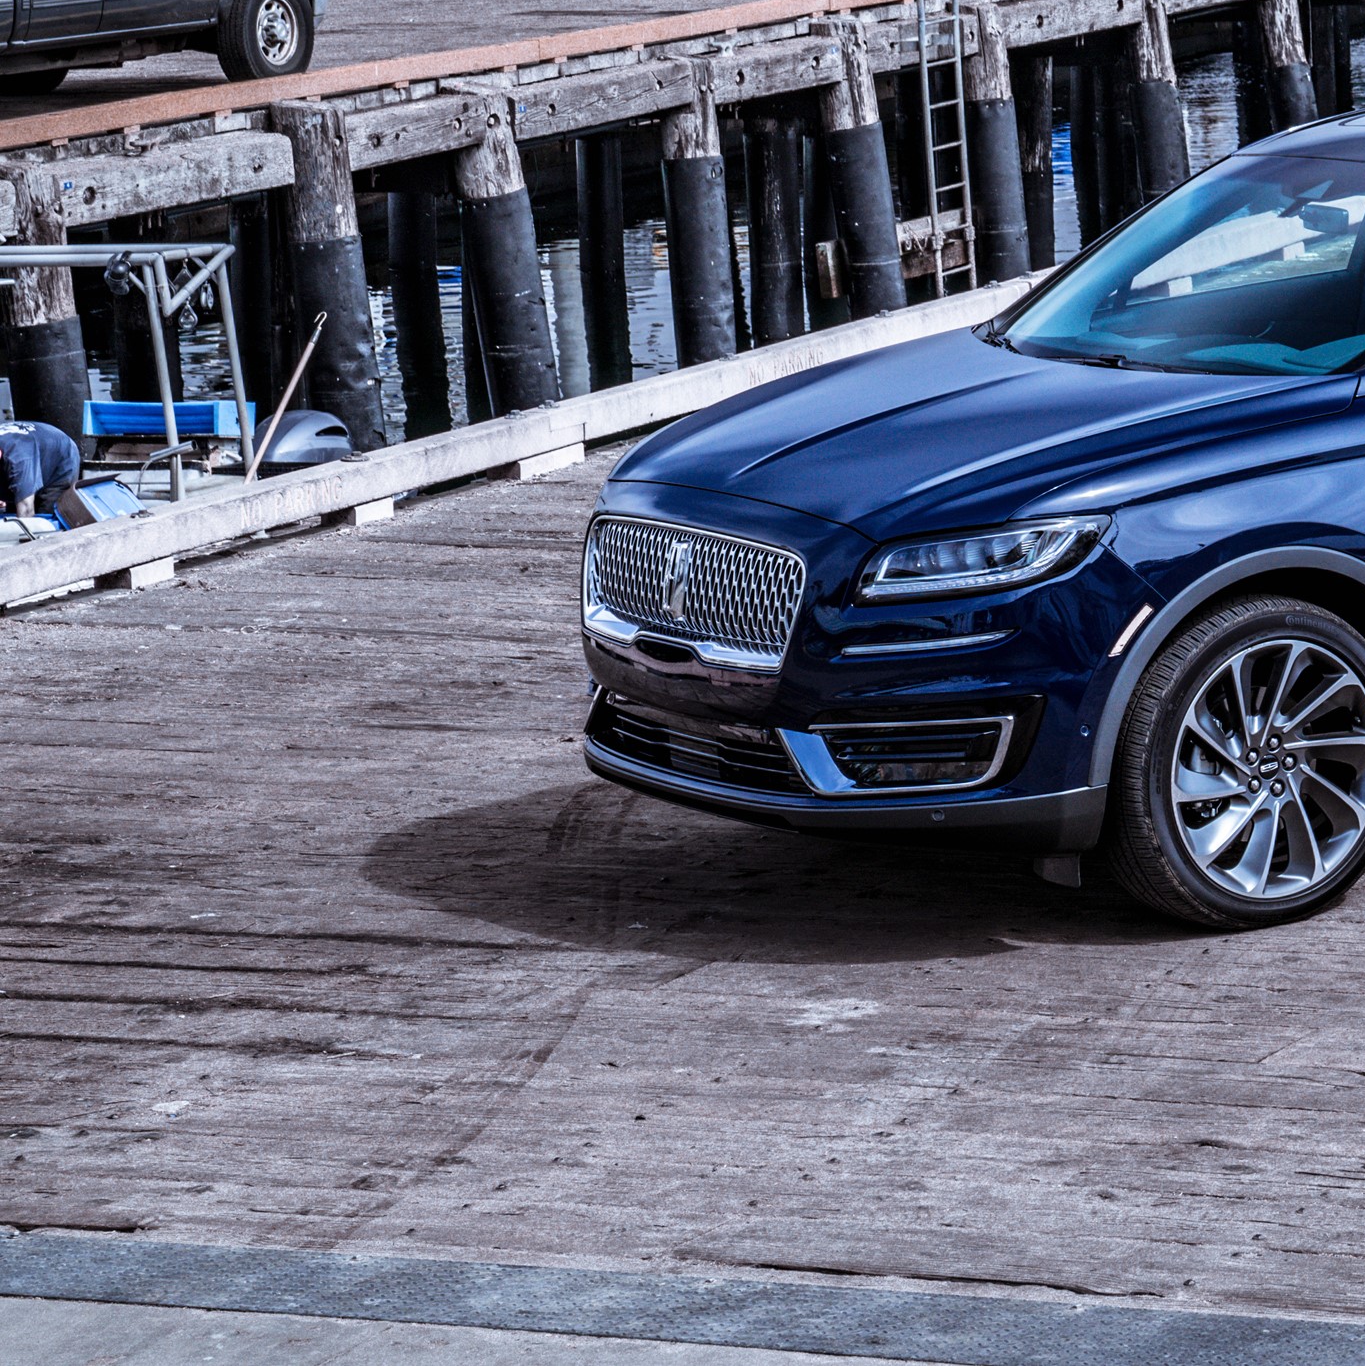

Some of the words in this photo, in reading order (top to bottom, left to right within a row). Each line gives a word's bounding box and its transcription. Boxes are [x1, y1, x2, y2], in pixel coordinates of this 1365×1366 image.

[748, 361, 765, 386] NO
[772, 344, 824, 380] PARKING
[241, 498, 262, 532] NO
[275, 475, 343, 520] PARKING
